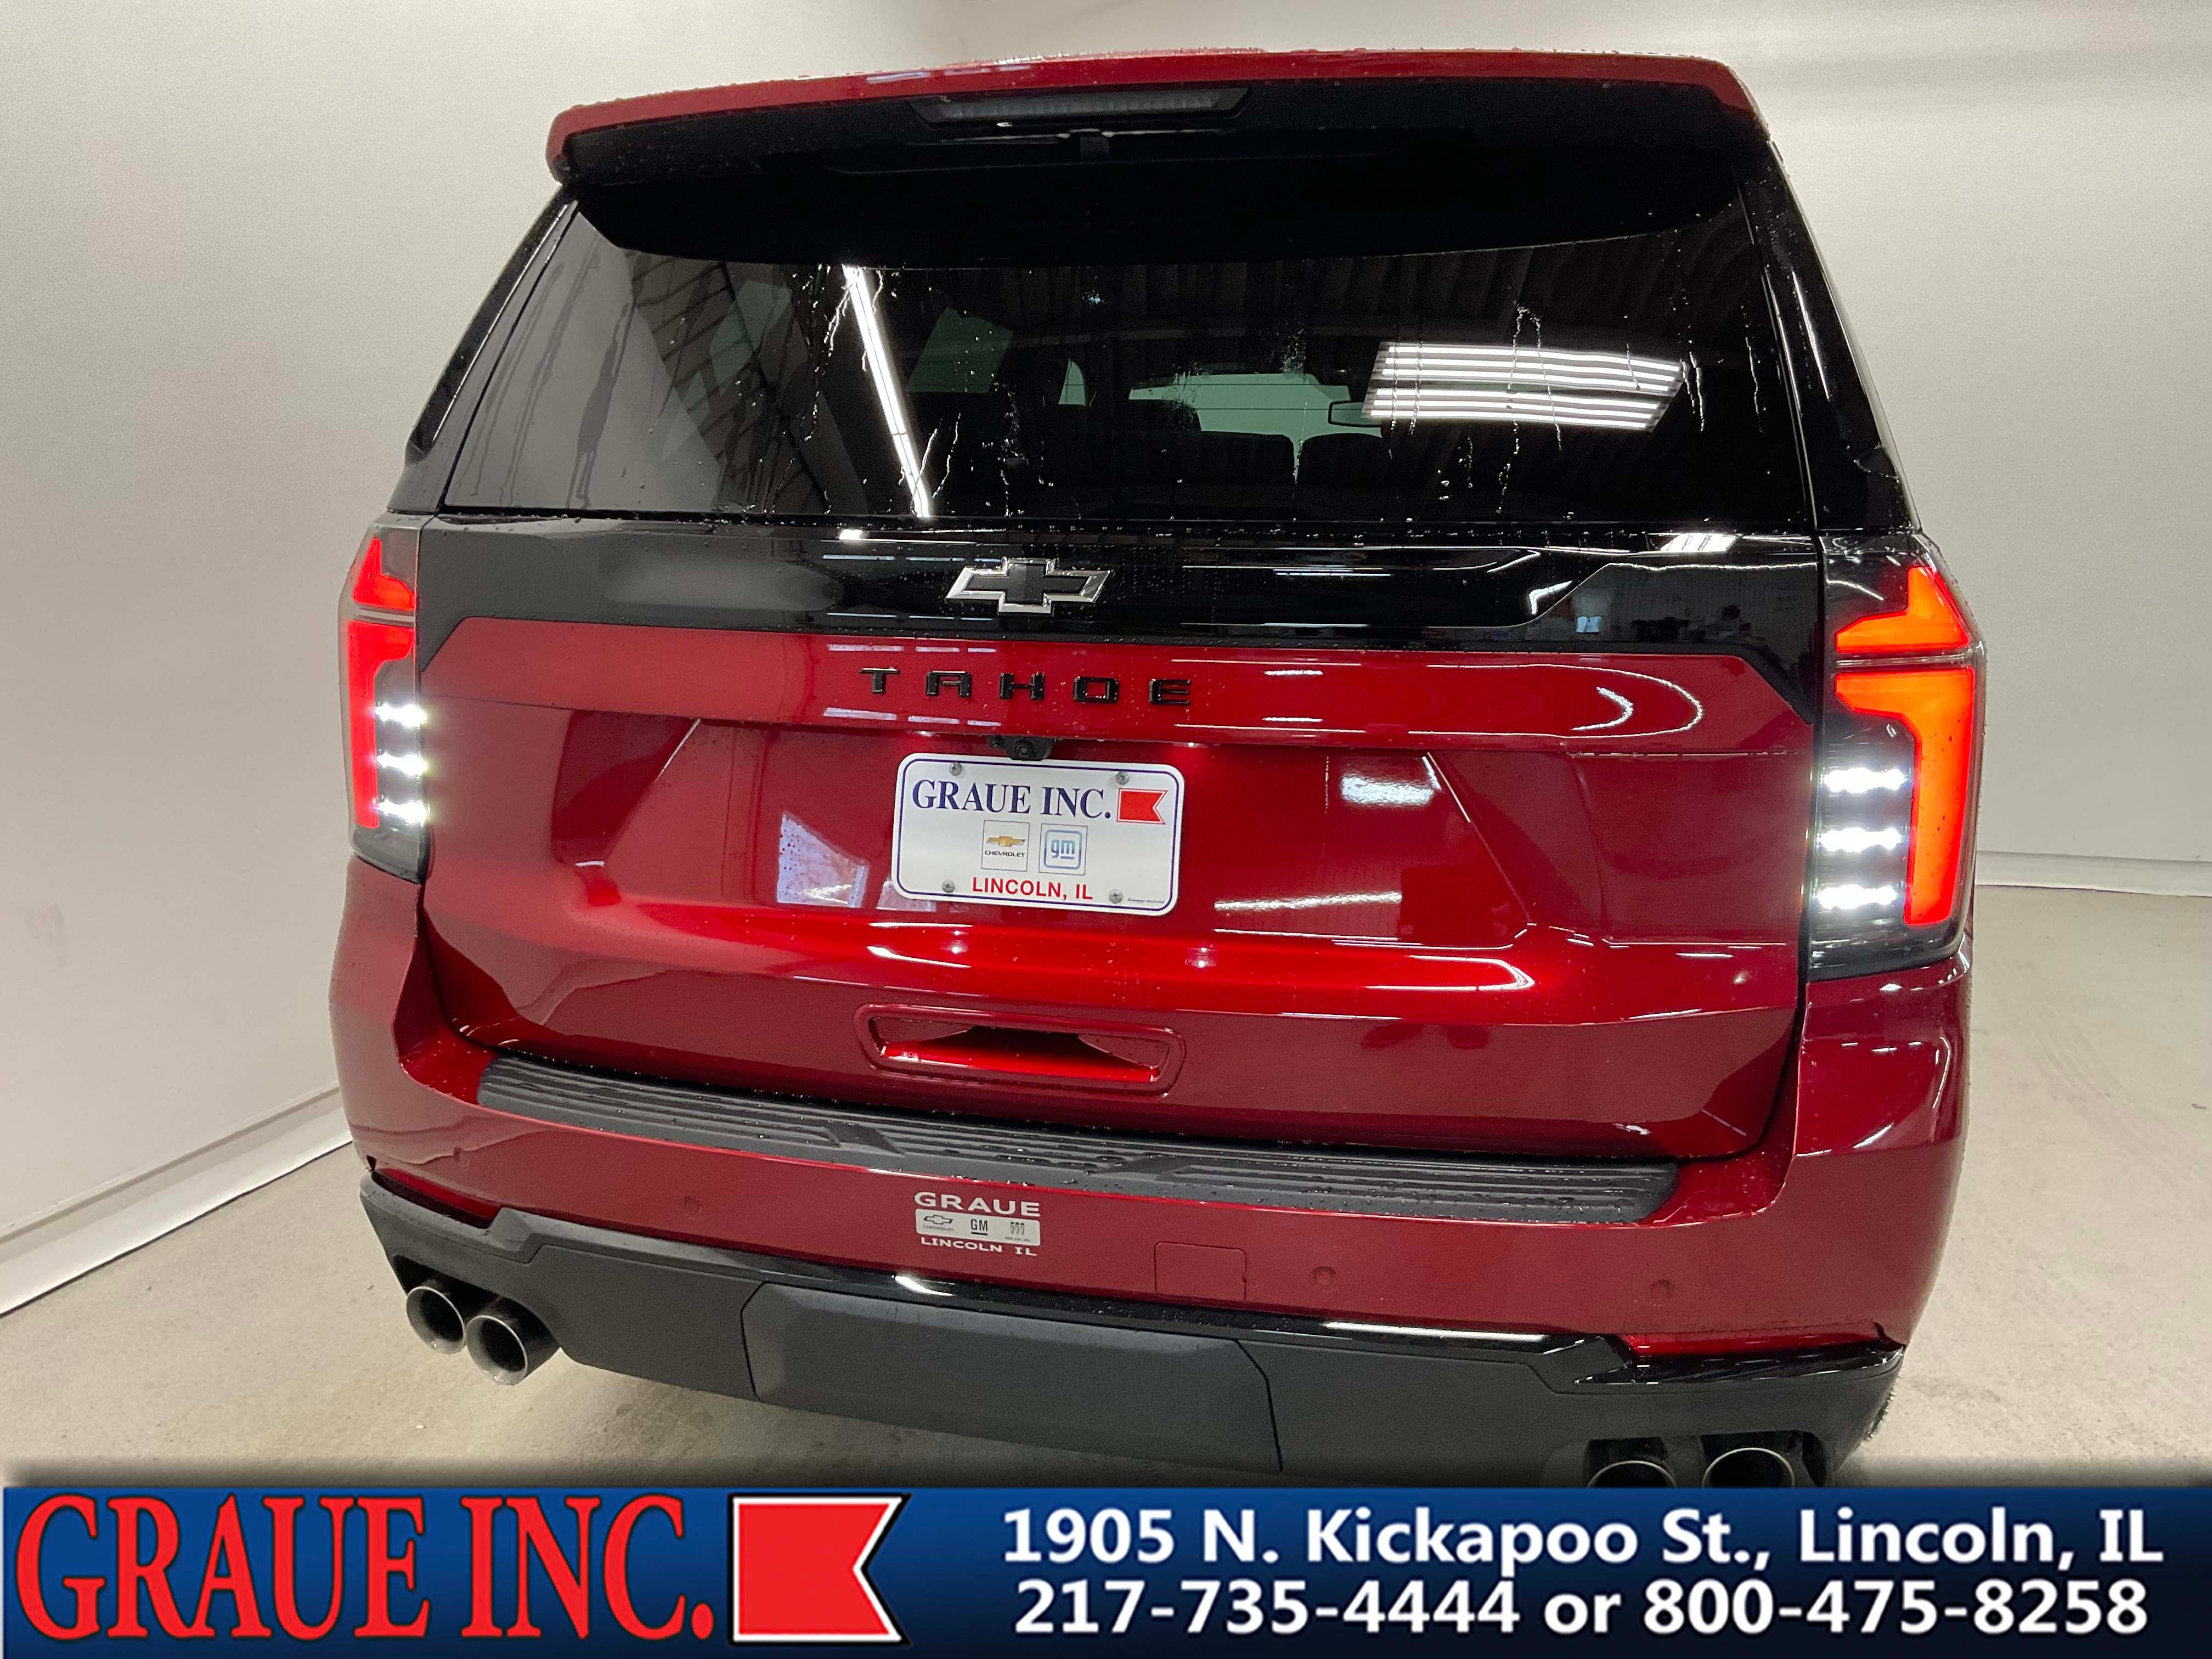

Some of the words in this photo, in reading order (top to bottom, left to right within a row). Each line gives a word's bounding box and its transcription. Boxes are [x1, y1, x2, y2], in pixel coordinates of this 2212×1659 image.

[860, 666, 1192, 706] TAHOE
[912, 779, 1031, 814] GRAUE
[1040, 787, 1111, 820] INC.
[1051, 839, 1075, 859] gm
[972, 877, 1066, 899] LINCOLN,
[1075, 885, 1093, 900] IL
[915, 1191, 1041, 1217] GRAUE
[970, 1218, 988, 1232] GM
[921, 1237, 1002, 1252] LINCOLN
[1015, 1246, 1037, 1256] IL
